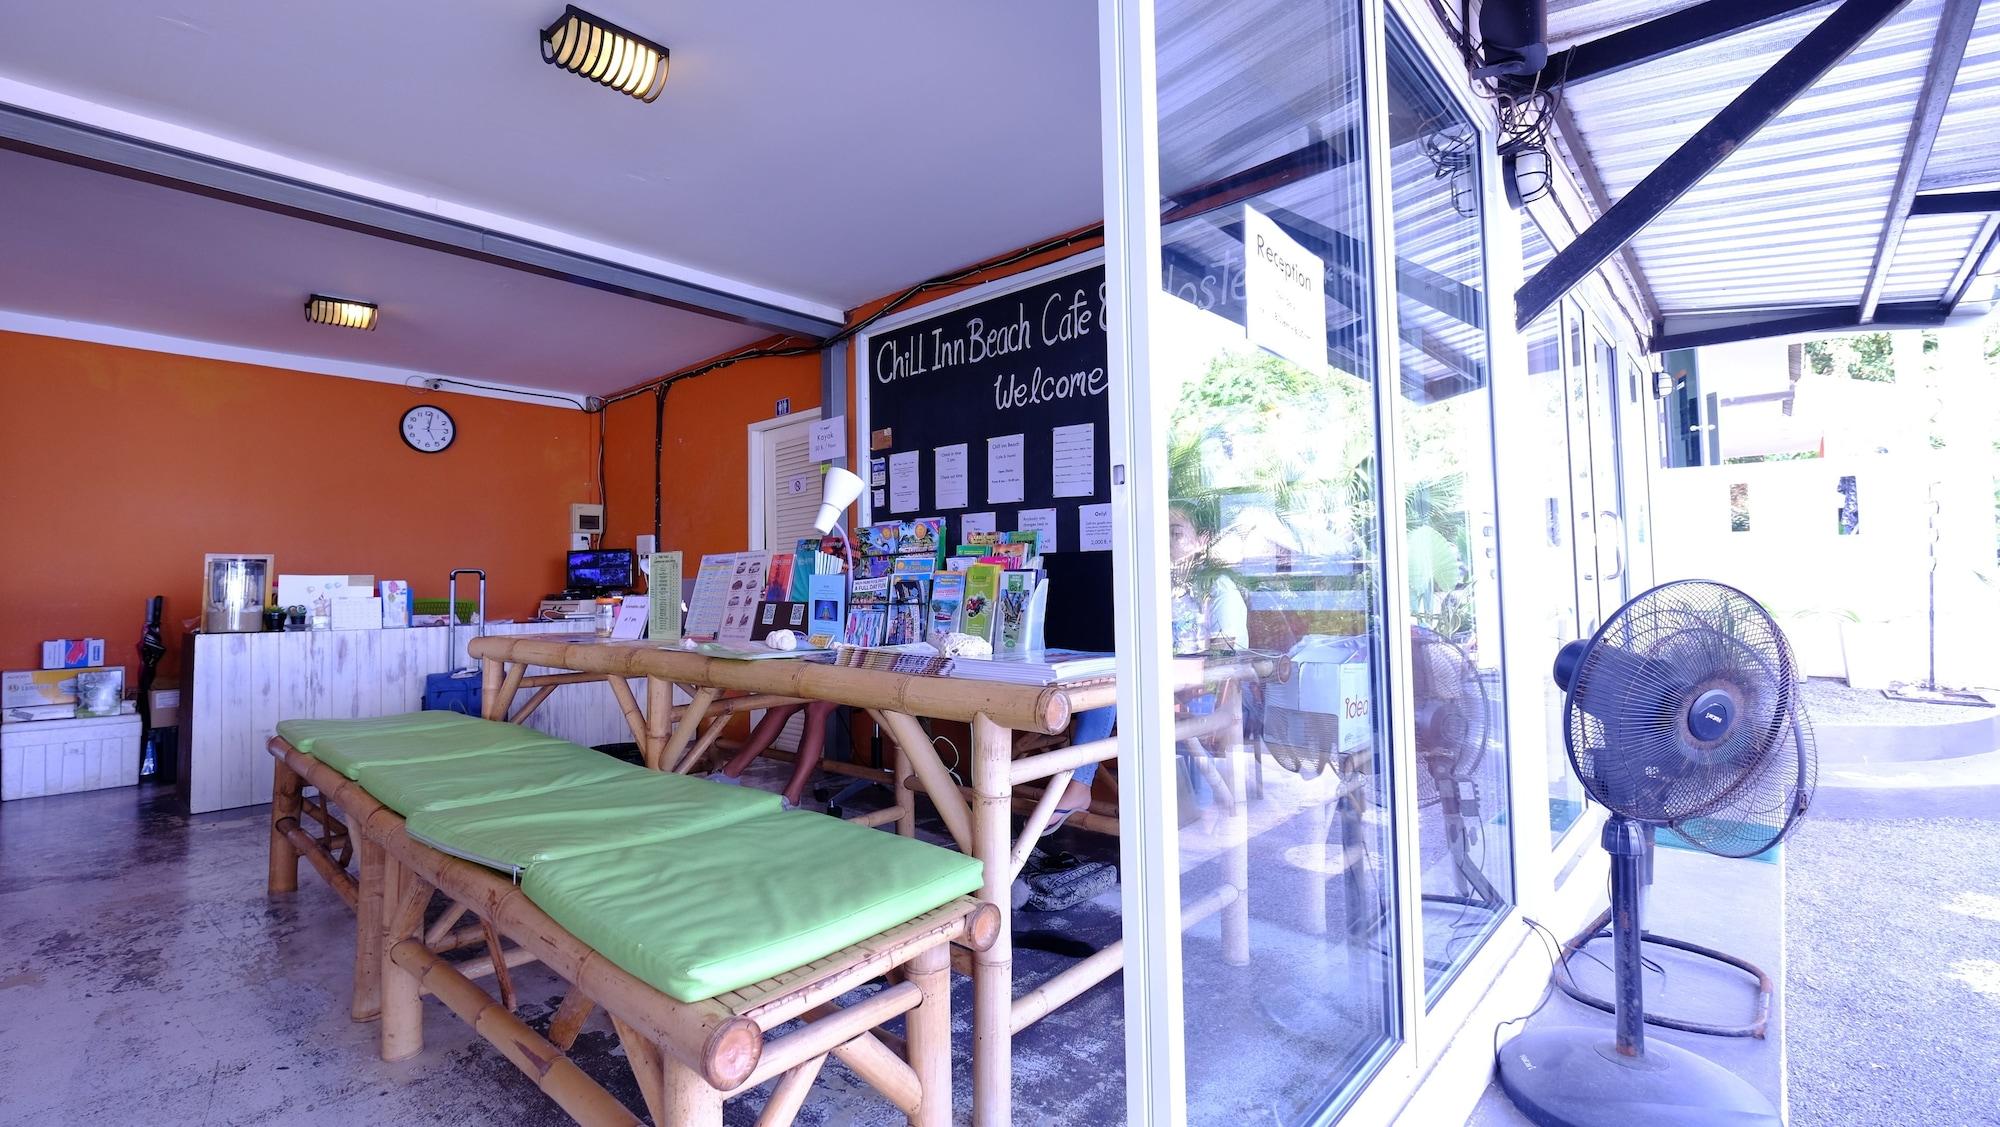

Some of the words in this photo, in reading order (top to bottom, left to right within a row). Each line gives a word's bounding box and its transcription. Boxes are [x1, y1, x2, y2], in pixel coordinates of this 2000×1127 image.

[1256, 233, 1312, 292] Reception
[931, 328, 965, 371] Inn
[967, 302, 1031, 363] Beach
[1041, 289, 1092, 346] Cafe
[994, 366, 1109, 410] Welcome
[817, 431, 834, 441] Kayak
